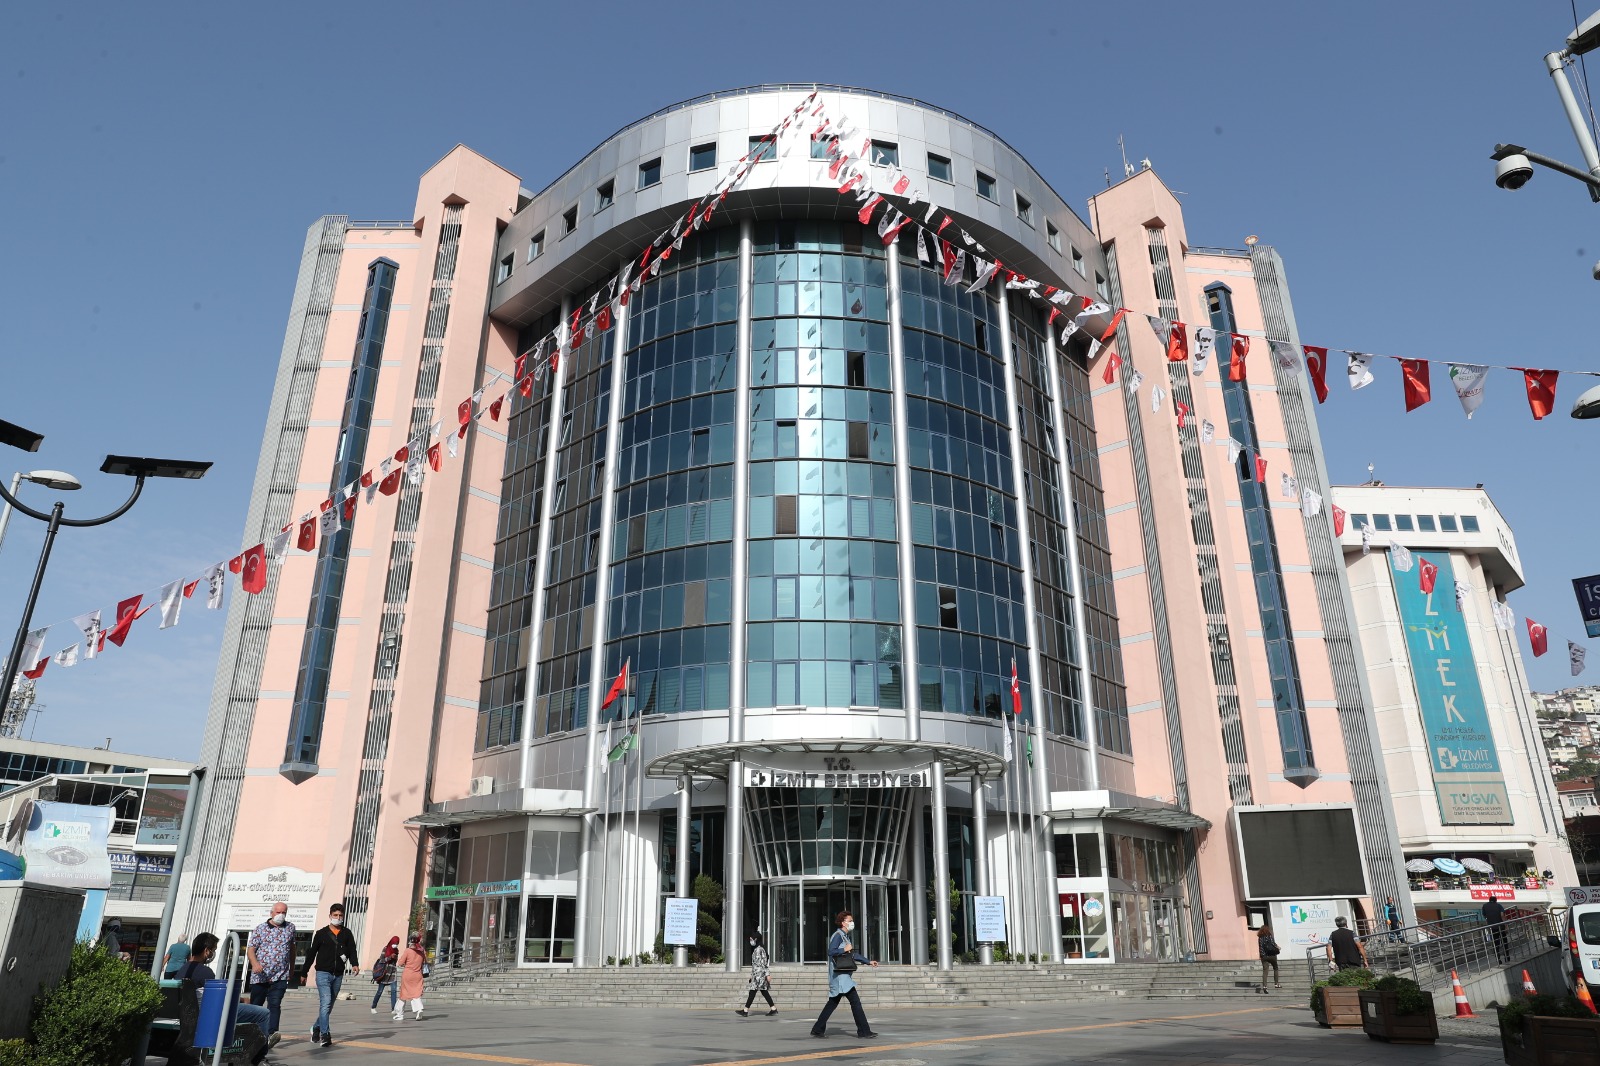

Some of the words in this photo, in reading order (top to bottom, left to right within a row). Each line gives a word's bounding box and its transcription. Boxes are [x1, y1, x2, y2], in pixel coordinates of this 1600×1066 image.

[1458, 747, 1489, 761] İZMİT
[824, 757, 855, 771] T.C.
[1462, 761, 1493, 769] BELEDİYESİ
[771, 770, 818, 787] İZMİT
[825, 771, 927, 788] BELEDİYESİ
[1450, 792, 1501, 805] TÜGVA
[62, 823, 88, 834] İZMİT
[146, 856, 169, 865] YAPI
[1308, 909, 1330, 918] İZMİT
